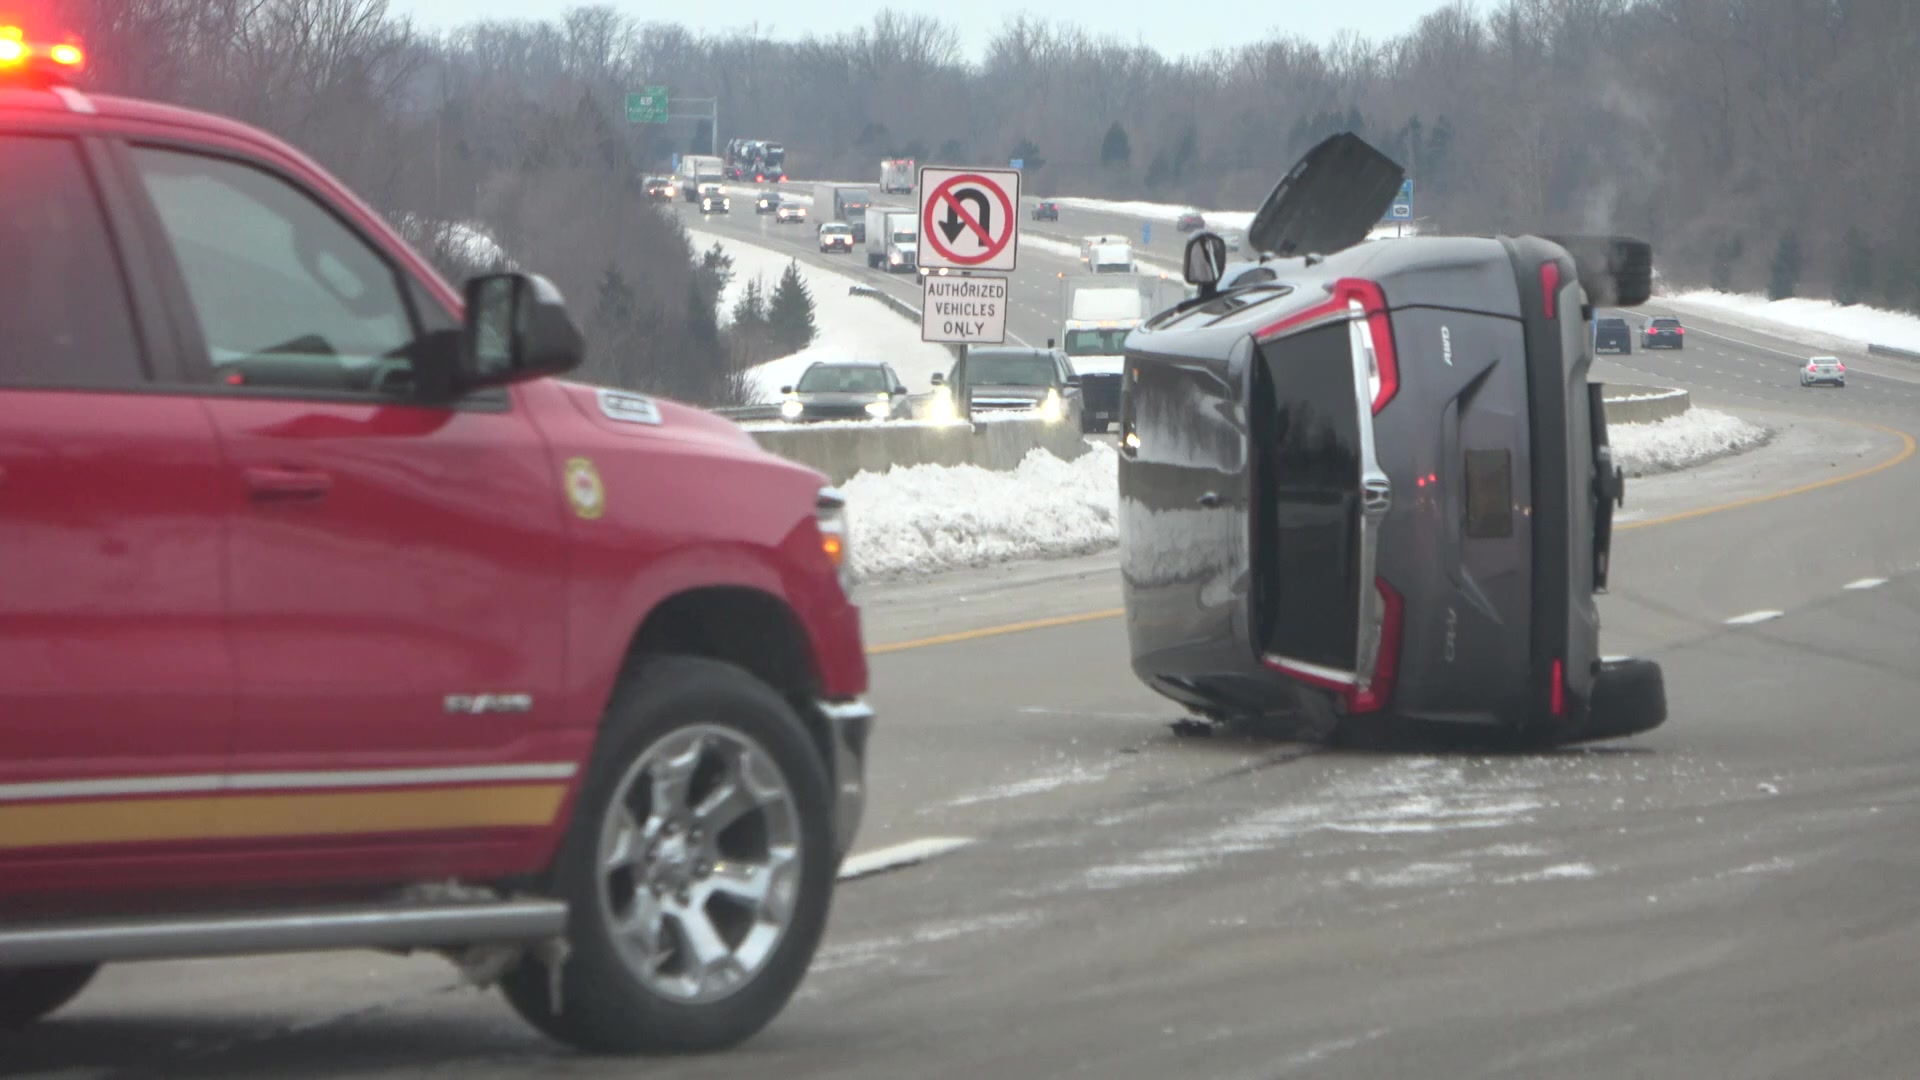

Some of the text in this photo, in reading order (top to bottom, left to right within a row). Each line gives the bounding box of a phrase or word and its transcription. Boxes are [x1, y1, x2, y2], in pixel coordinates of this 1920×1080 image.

[928, 282, 1004, 298] AUTHORIZED
[936, 302, 995, 316] VEHICLES
[943, 321, 984, 337] ONLY
[1441, 325, 1453, 367] AWD
